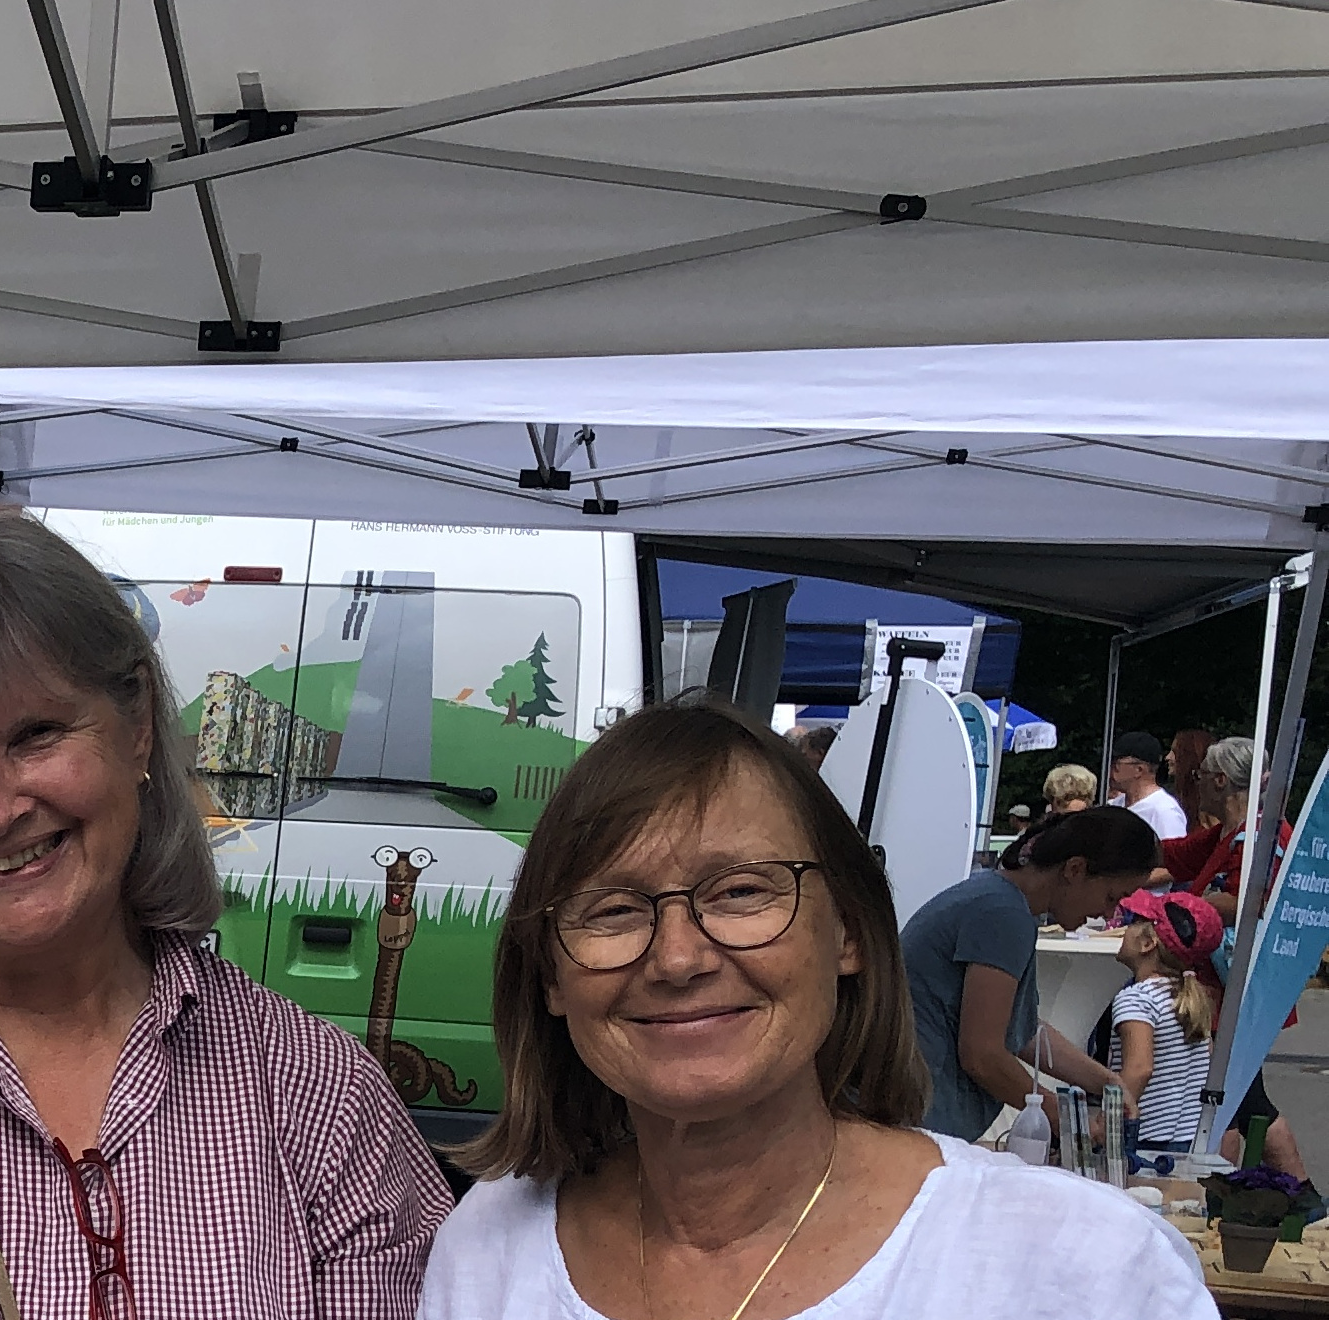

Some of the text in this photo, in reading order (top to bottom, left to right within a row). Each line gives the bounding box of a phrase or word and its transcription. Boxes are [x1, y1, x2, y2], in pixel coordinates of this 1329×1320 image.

[102, 515, 214, 527] für Mädchen und Jungen
[351, 521, 383, 532] HANS
[385, 522, 444, 534] HERMANN
[1311, 836, 1328, 860] für
[1271, 933, 1301, 958] Land
